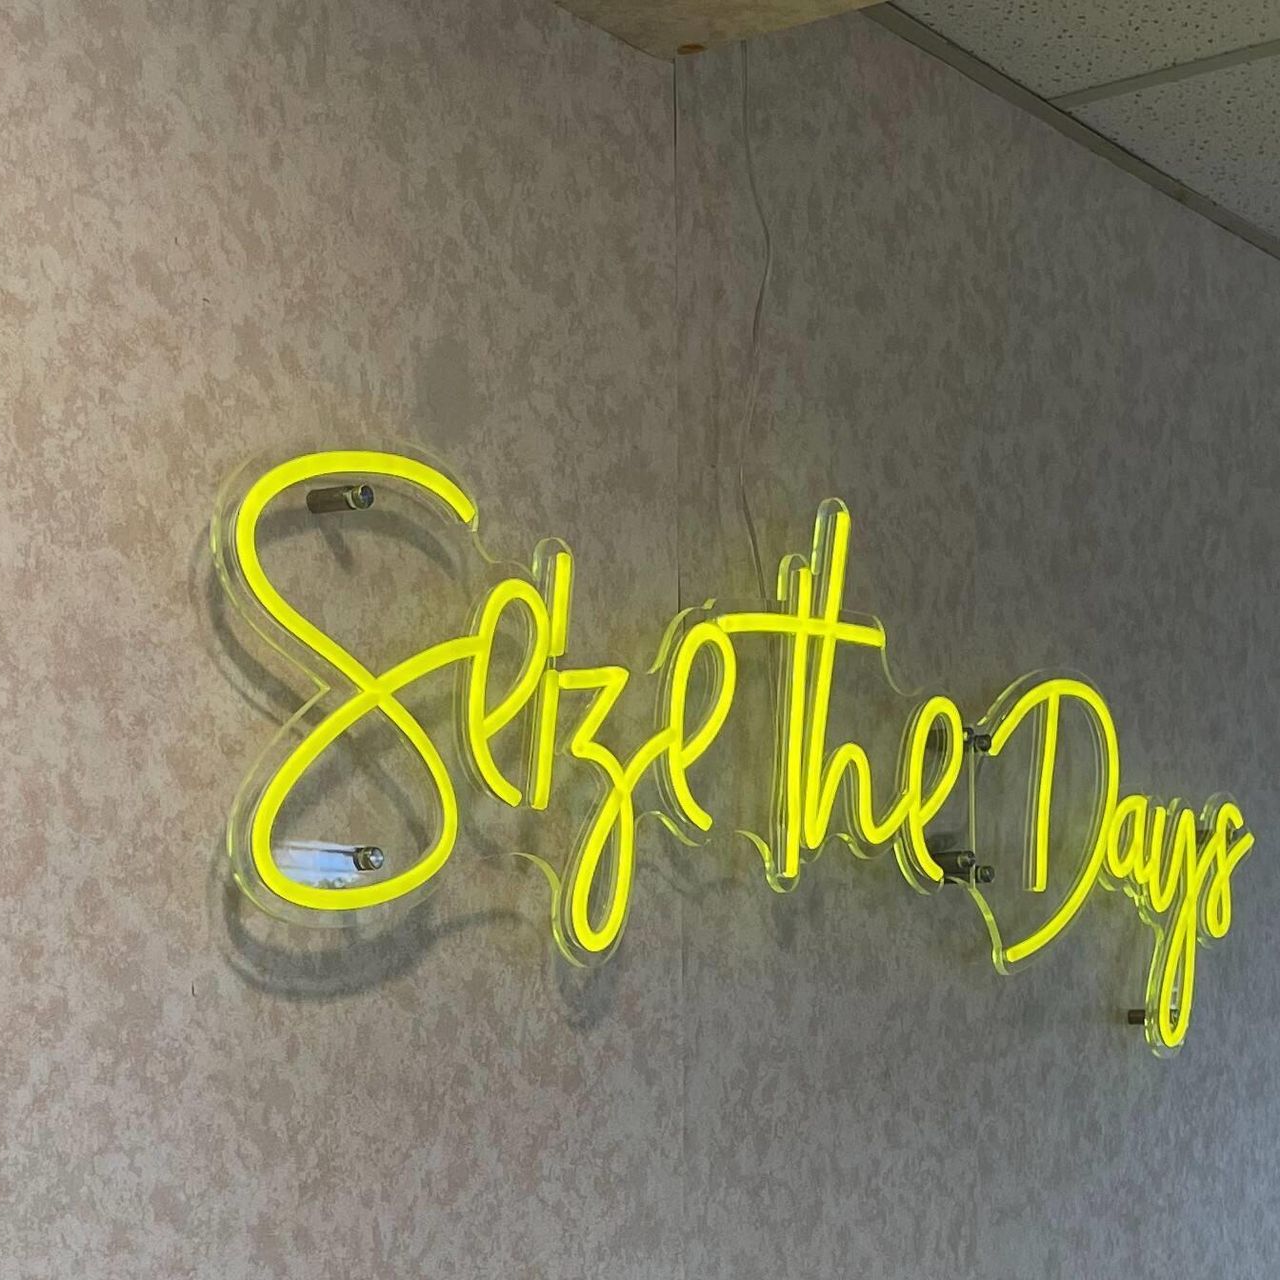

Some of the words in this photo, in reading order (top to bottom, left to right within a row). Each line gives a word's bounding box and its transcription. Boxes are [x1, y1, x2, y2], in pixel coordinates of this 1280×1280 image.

[235, 450, 736, 953] Seize
[718, 511, 965, 878] the
[987, 679, 1255, 1048] Days
